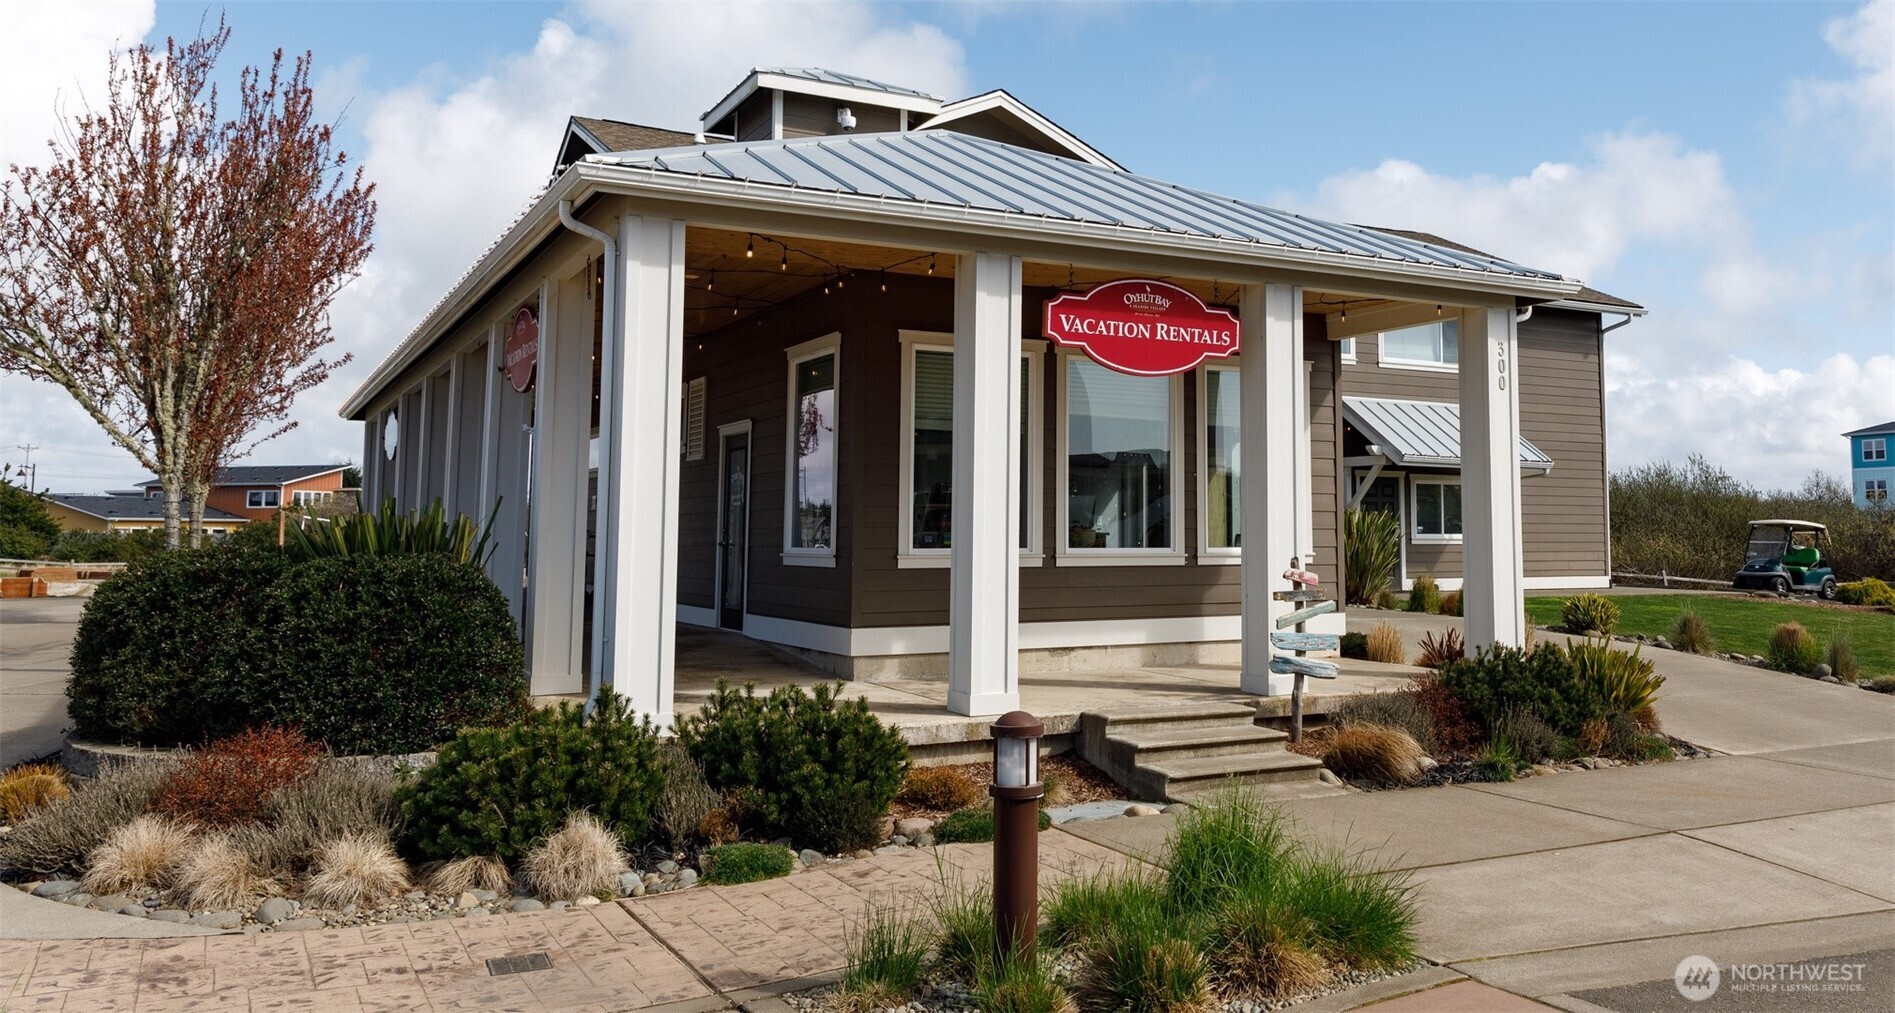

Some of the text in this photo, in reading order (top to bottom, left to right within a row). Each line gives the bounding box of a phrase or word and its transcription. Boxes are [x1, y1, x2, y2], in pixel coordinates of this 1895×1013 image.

[1059, 313, 1231, 346] VACATION RENTALS
[1497, 341, 1505, 391] 300
